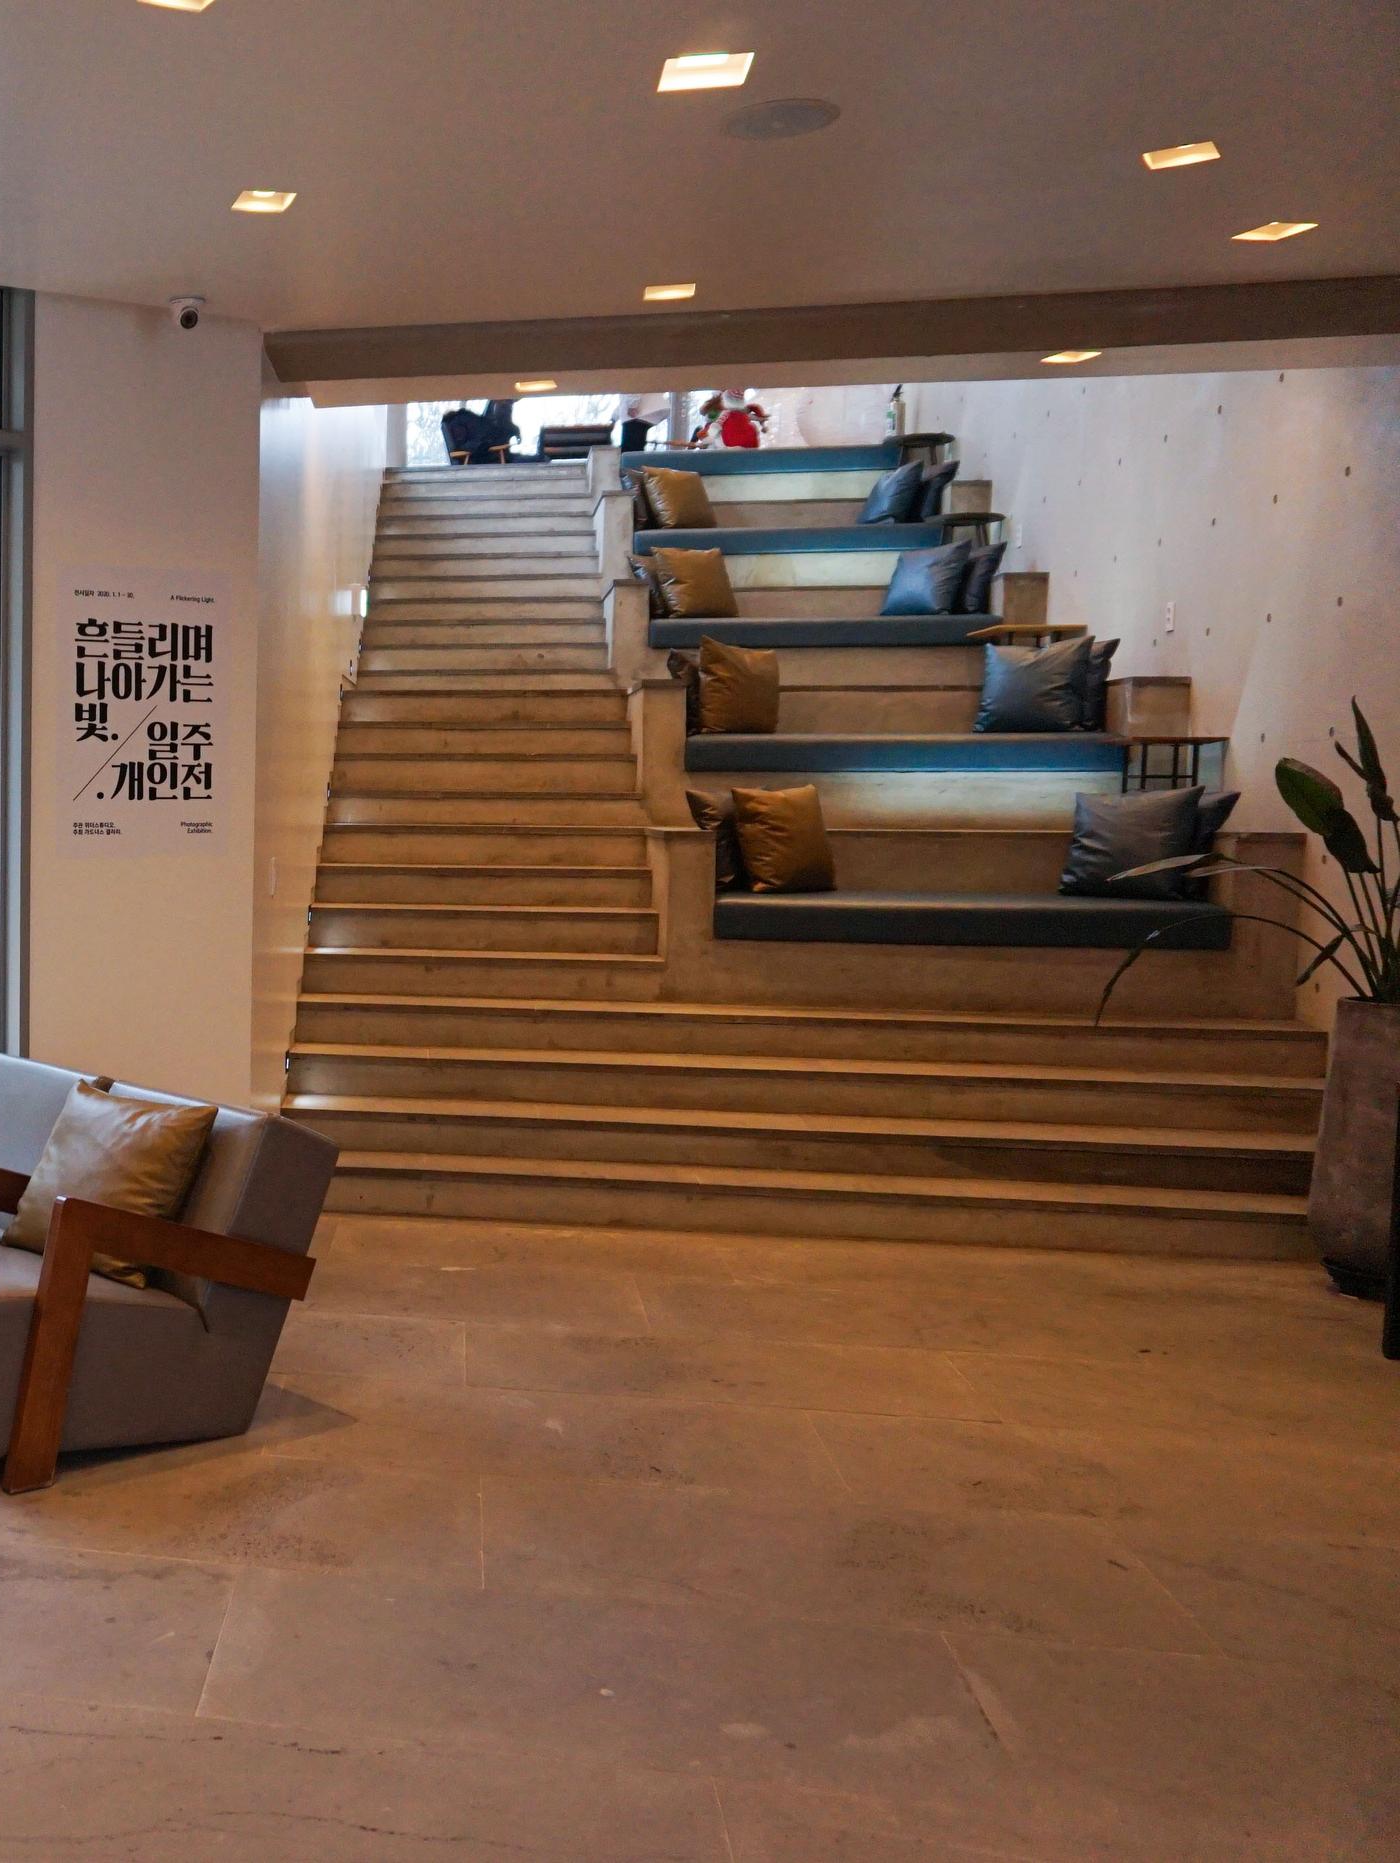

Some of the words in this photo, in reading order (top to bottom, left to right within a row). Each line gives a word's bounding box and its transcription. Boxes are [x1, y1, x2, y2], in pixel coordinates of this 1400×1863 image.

[74, 618, 213, 663] 흔들리며
[75, 661, 214, 703] 나아가는
[74, 702, 119, 743] 빛.
[147, 721, 214, 761] 일주
[180, 820, 213, 828] Photographic
